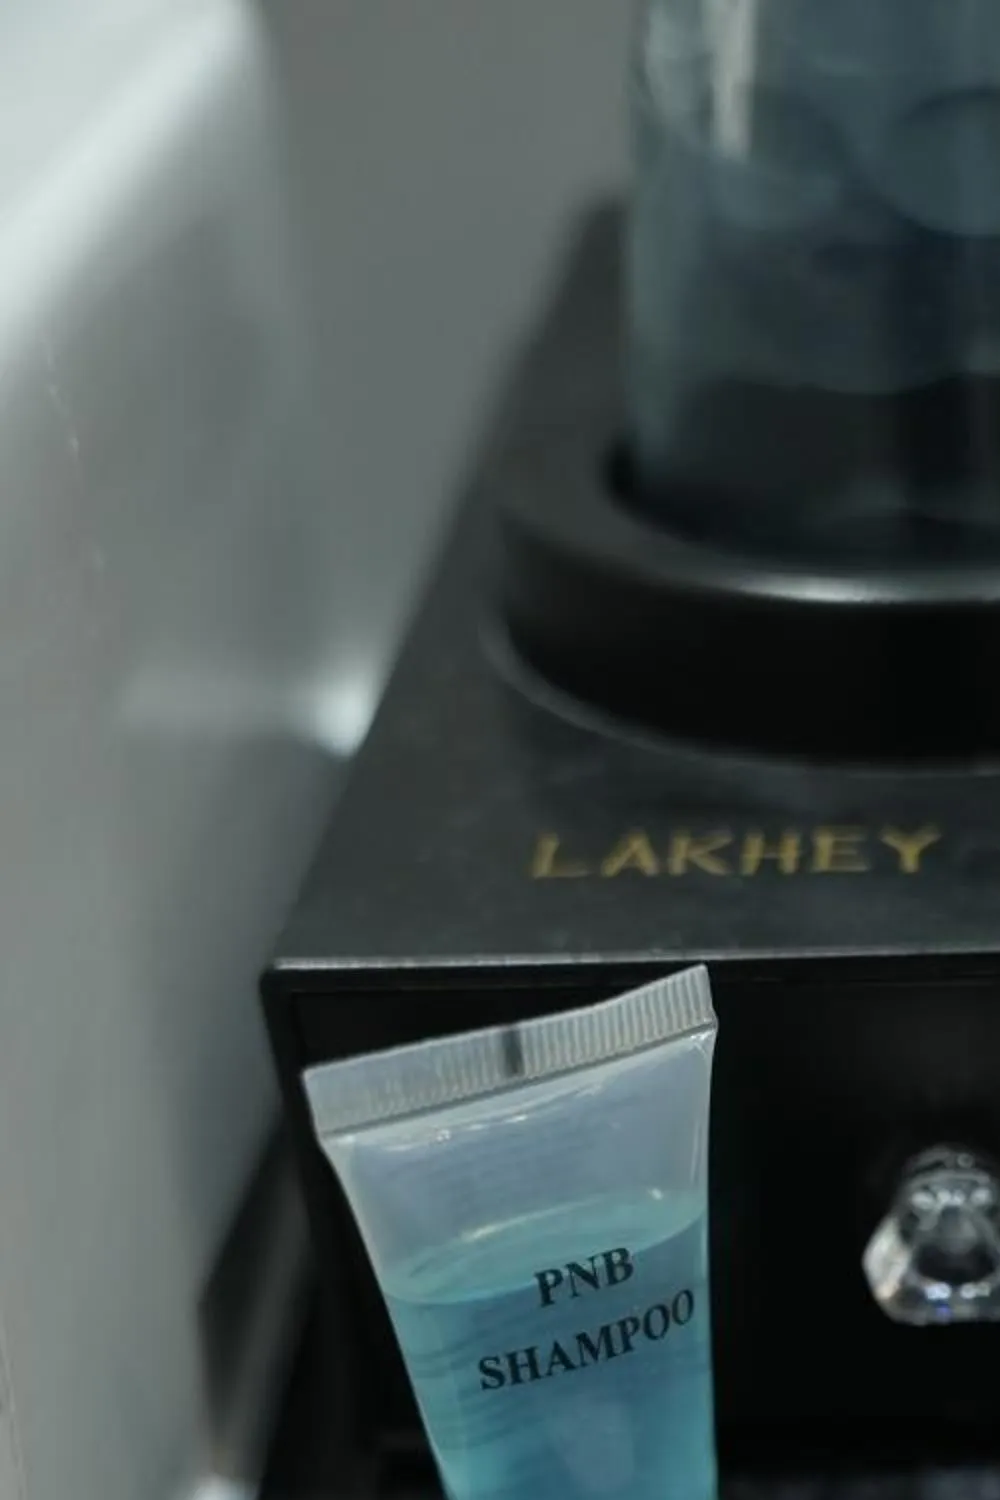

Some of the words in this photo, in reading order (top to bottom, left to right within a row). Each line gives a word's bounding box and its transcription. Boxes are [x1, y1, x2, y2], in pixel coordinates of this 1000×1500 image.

[531, 823, 943, 879] LAKHEY
[533, 1247, 634, 1308] PNB
[478, 1288, 695, 1391] SHAMPOO
